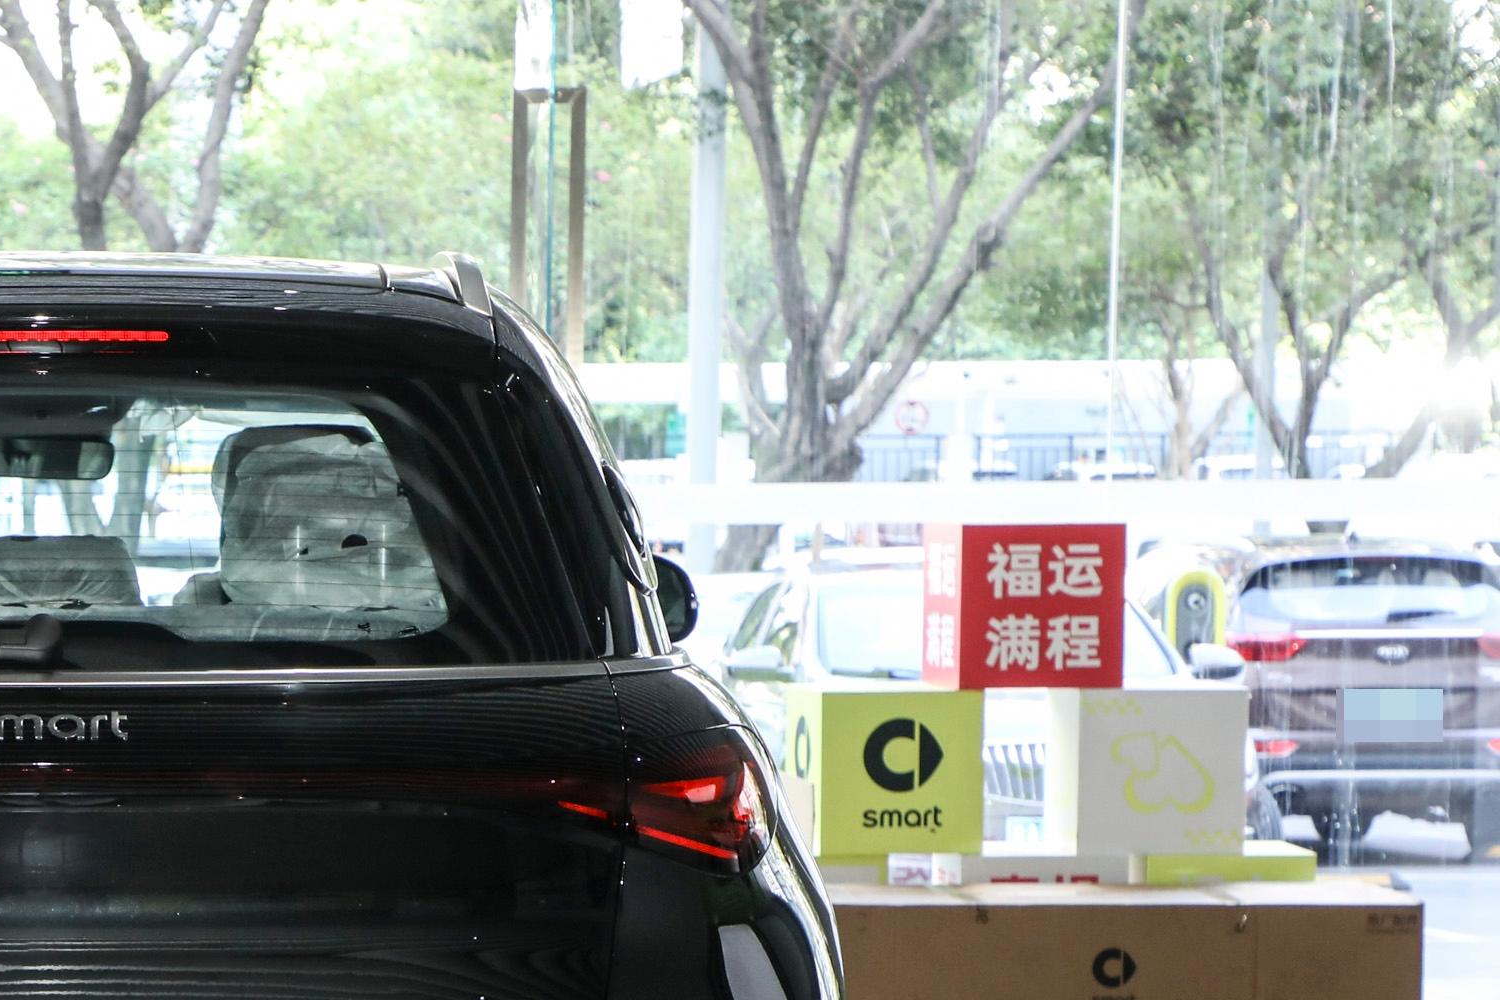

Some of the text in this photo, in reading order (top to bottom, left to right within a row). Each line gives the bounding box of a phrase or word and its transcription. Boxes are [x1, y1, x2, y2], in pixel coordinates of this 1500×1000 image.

[986, 542, 1103, 599] 福运
[985, 613, 1101, 671] 满程
[863, 806, 943, 828] smart
